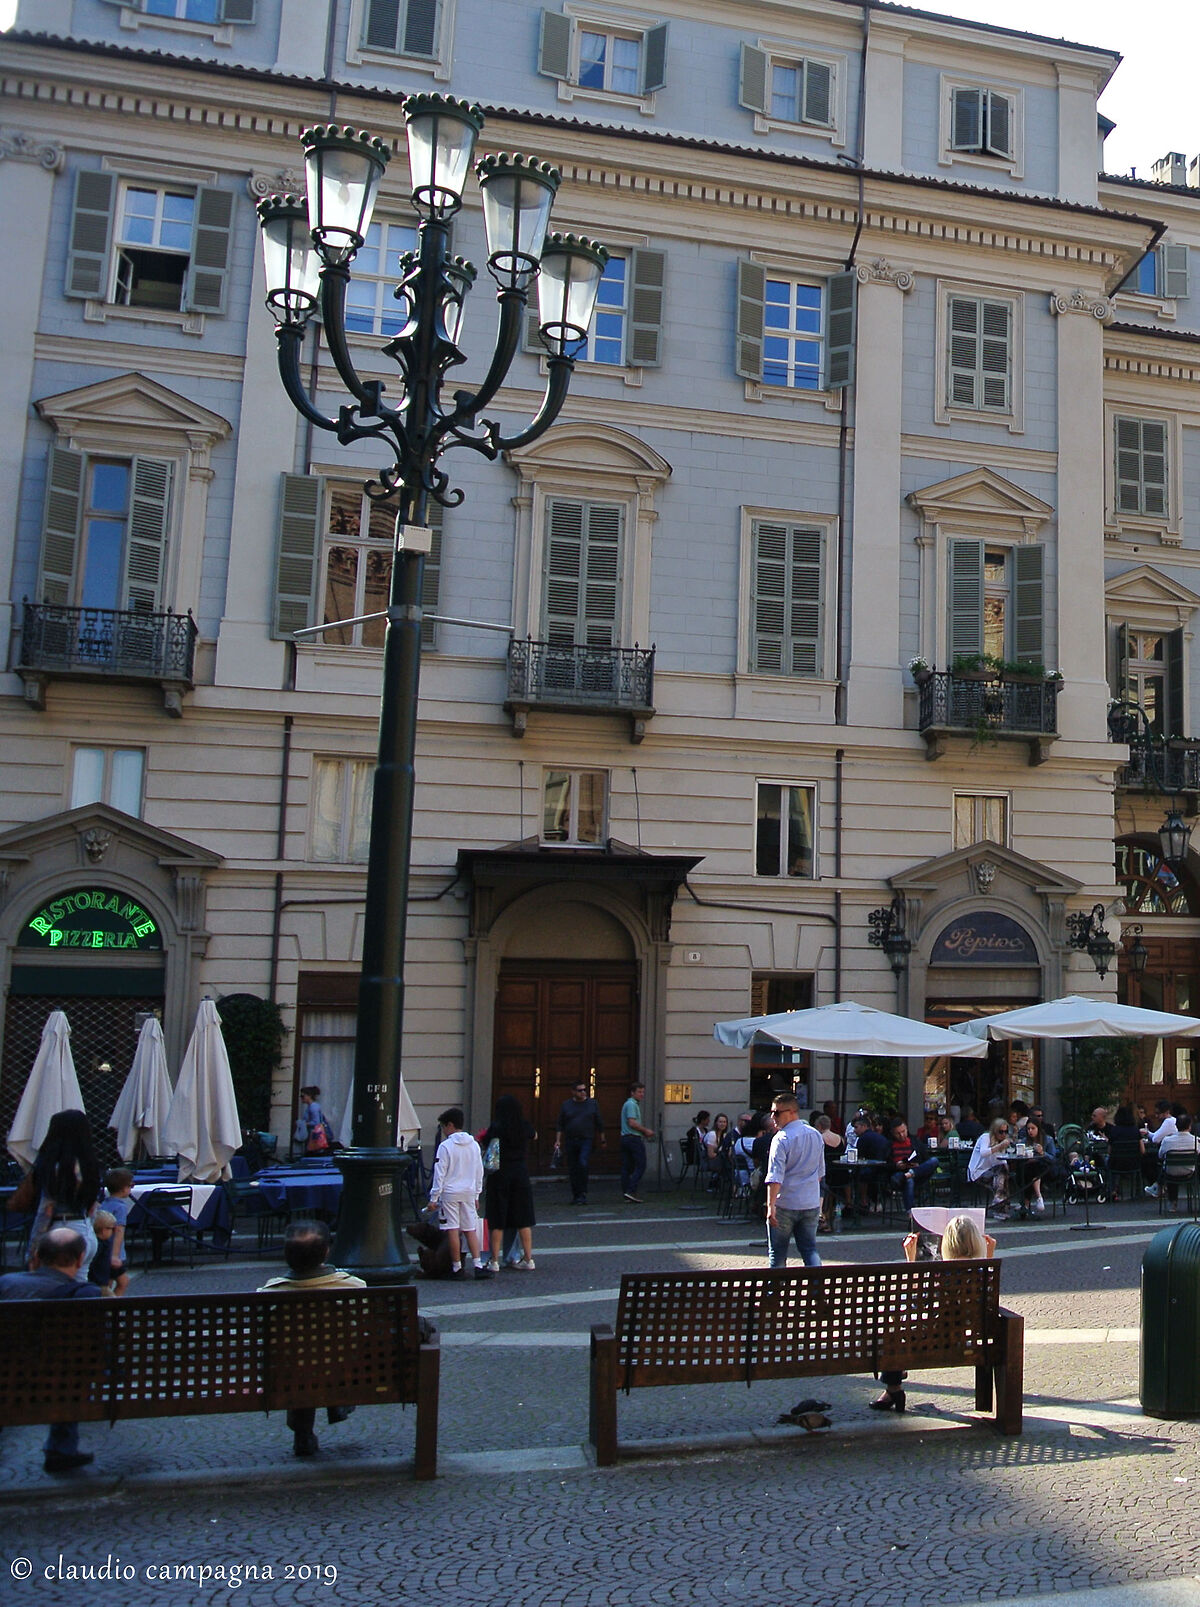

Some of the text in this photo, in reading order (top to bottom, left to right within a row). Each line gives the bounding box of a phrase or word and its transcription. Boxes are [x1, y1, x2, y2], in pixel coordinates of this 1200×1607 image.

[29, 891, 156, 938] RISTORANTE
[49, 929, 139, 948] PIZZERIA
[944, 927, 1025, 957] Pepino
